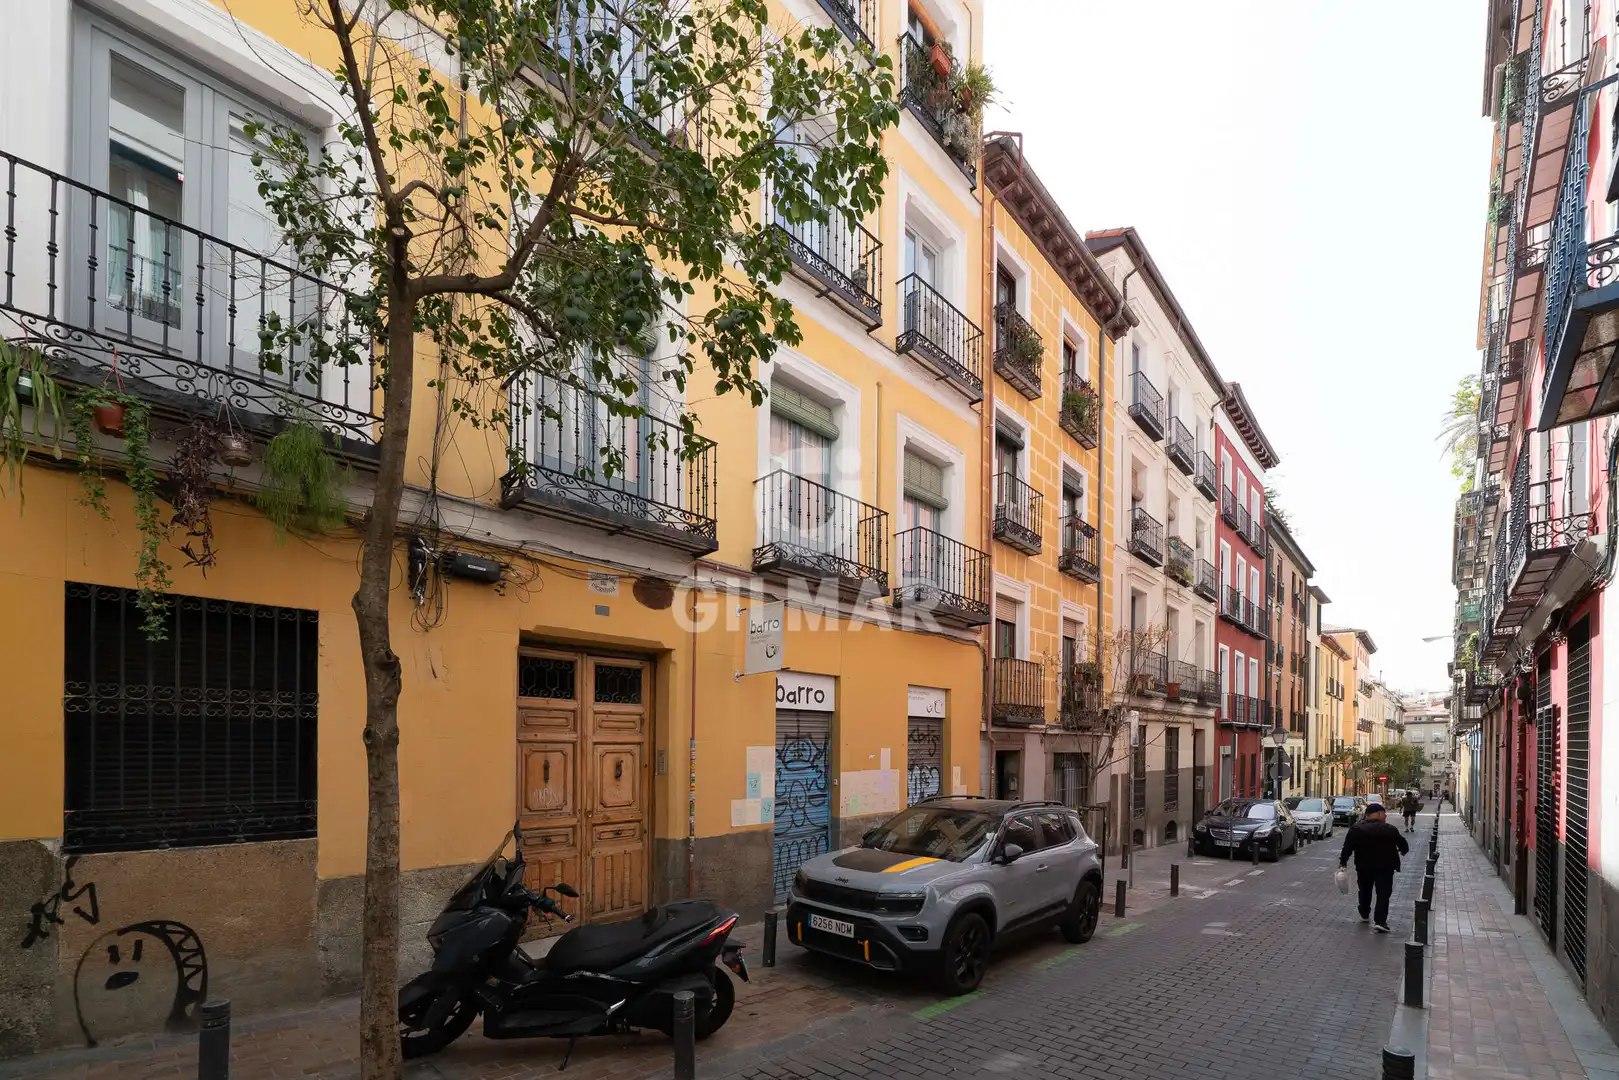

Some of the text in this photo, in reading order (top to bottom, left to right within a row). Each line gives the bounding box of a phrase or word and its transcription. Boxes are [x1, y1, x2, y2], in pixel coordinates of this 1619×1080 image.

[750, 619, 780, 634] barro
[775, 677, 825, 704] barro
[813, 916, 852, 935] 6256 NDM
